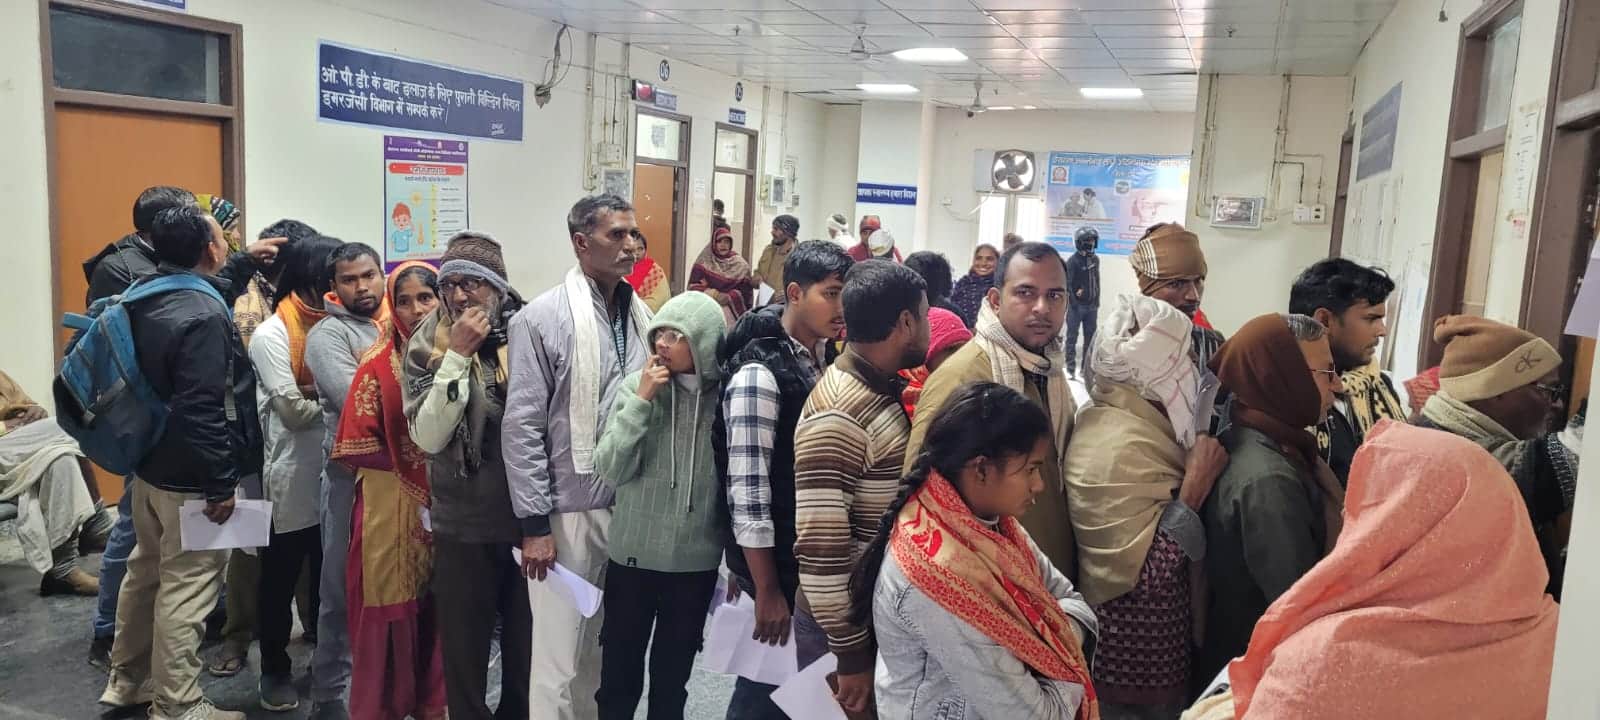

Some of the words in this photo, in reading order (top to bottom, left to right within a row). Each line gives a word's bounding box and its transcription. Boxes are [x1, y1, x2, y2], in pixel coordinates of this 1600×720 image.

[383, 78, 400, 95] बाद
[428, 82, 436, 98] के
[436, 82, 453, 104] लिए
[370, 92, 394, 115] विभाग
[396, 97, 404, 116] में
